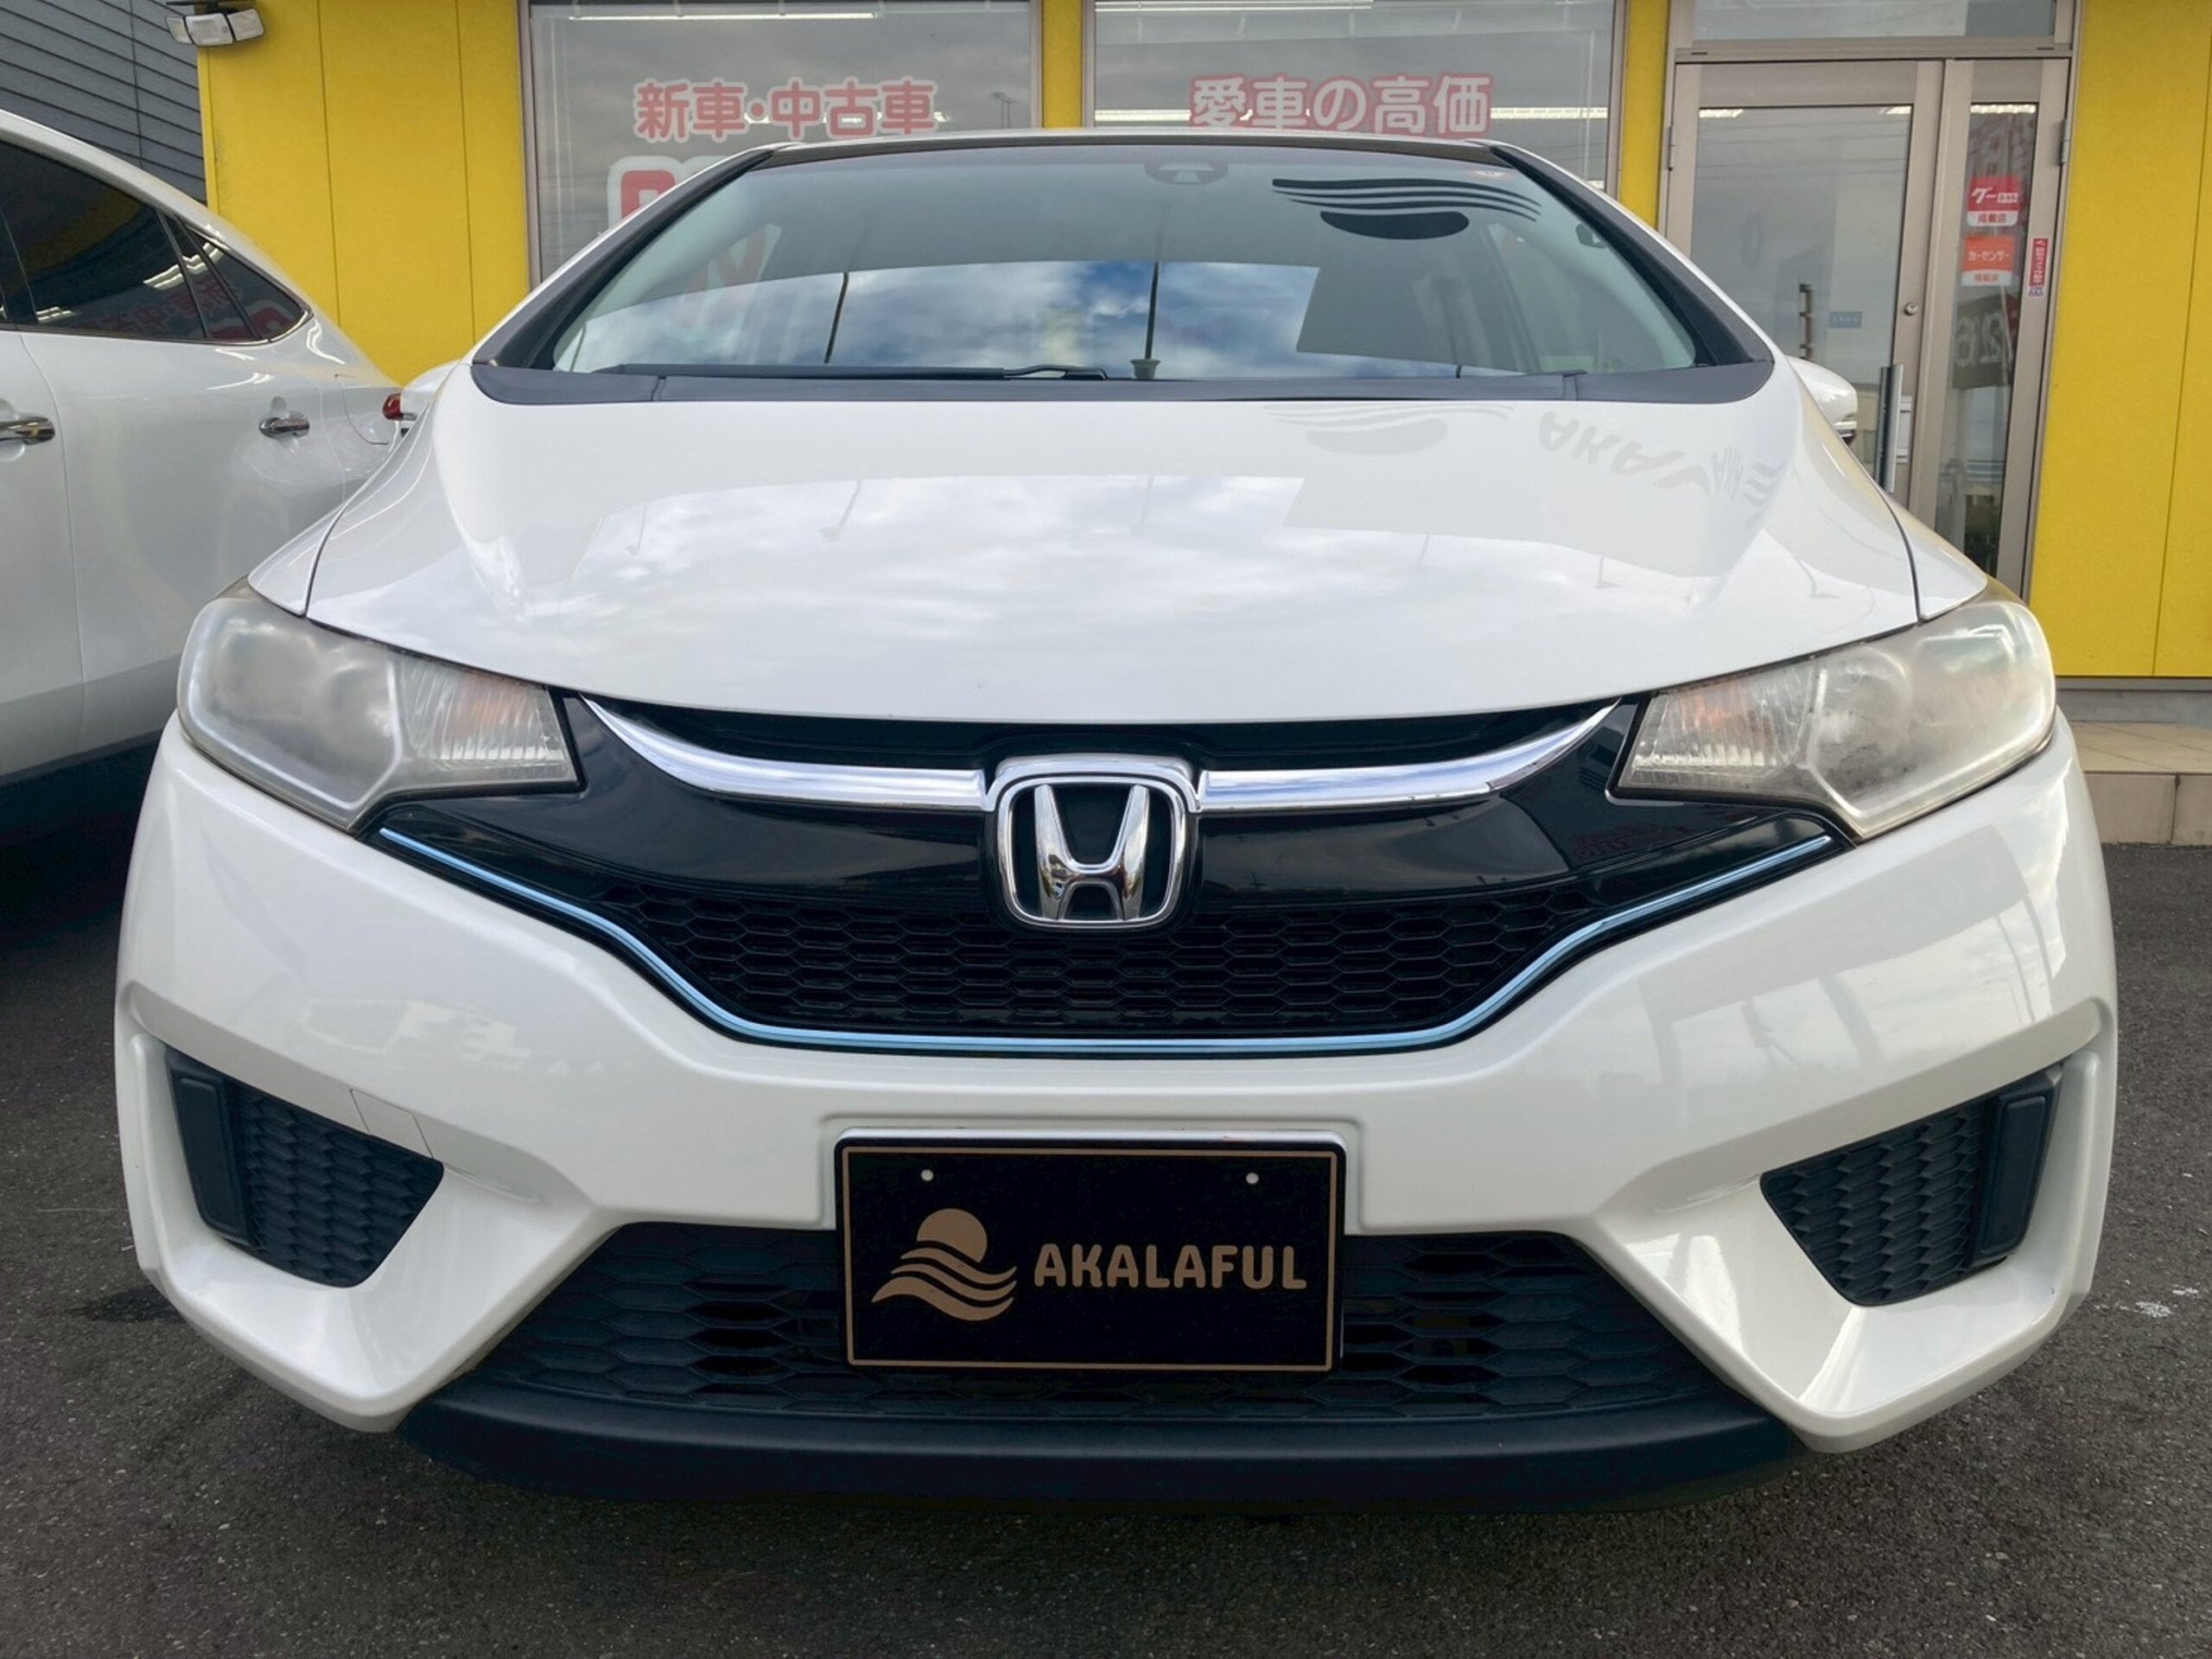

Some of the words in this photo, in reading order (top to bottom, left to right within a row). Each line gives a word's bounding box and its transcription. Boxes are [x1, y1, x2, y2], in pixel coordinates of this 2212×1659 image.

[635, 79, 937, 141] 新車・中古車
[1191, 73, 1492, 137] 愛車の高価
[1967, 250, 2010, 262] カーセンサー
[1034, 1243, 1307, 1290] AKALAFUL
